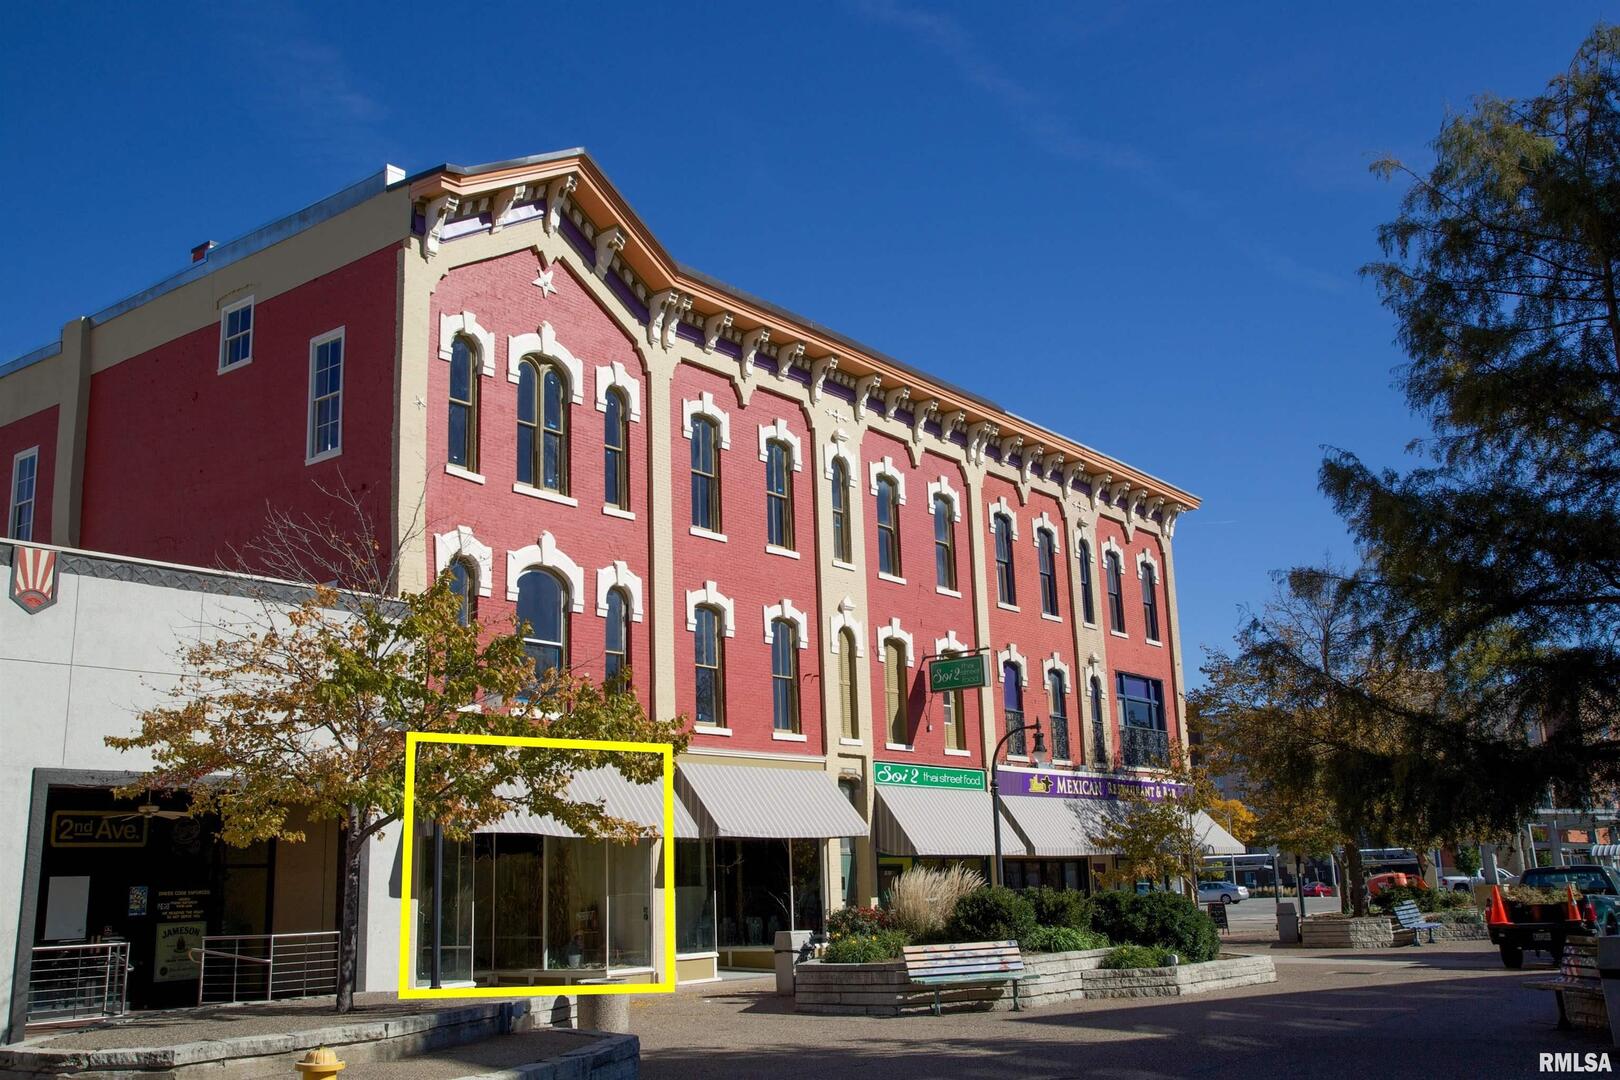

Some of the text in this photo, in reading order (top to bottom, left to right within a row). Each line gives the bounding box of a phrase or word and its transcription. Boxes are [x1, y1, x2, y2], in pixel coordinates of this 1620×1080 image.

[933, 667, 960, 684] Soi 2
[877, 765, 909, 783] Soi
[911, 768, 919, 784] 2
[923, 771, 939, 783] thai
[940, 773, 962, 784] street
[1155, 785, 1162, 798] &
[59, 819, 140, 840] 2nd Ave.
[162, 926, 201, 939] JAMESON
